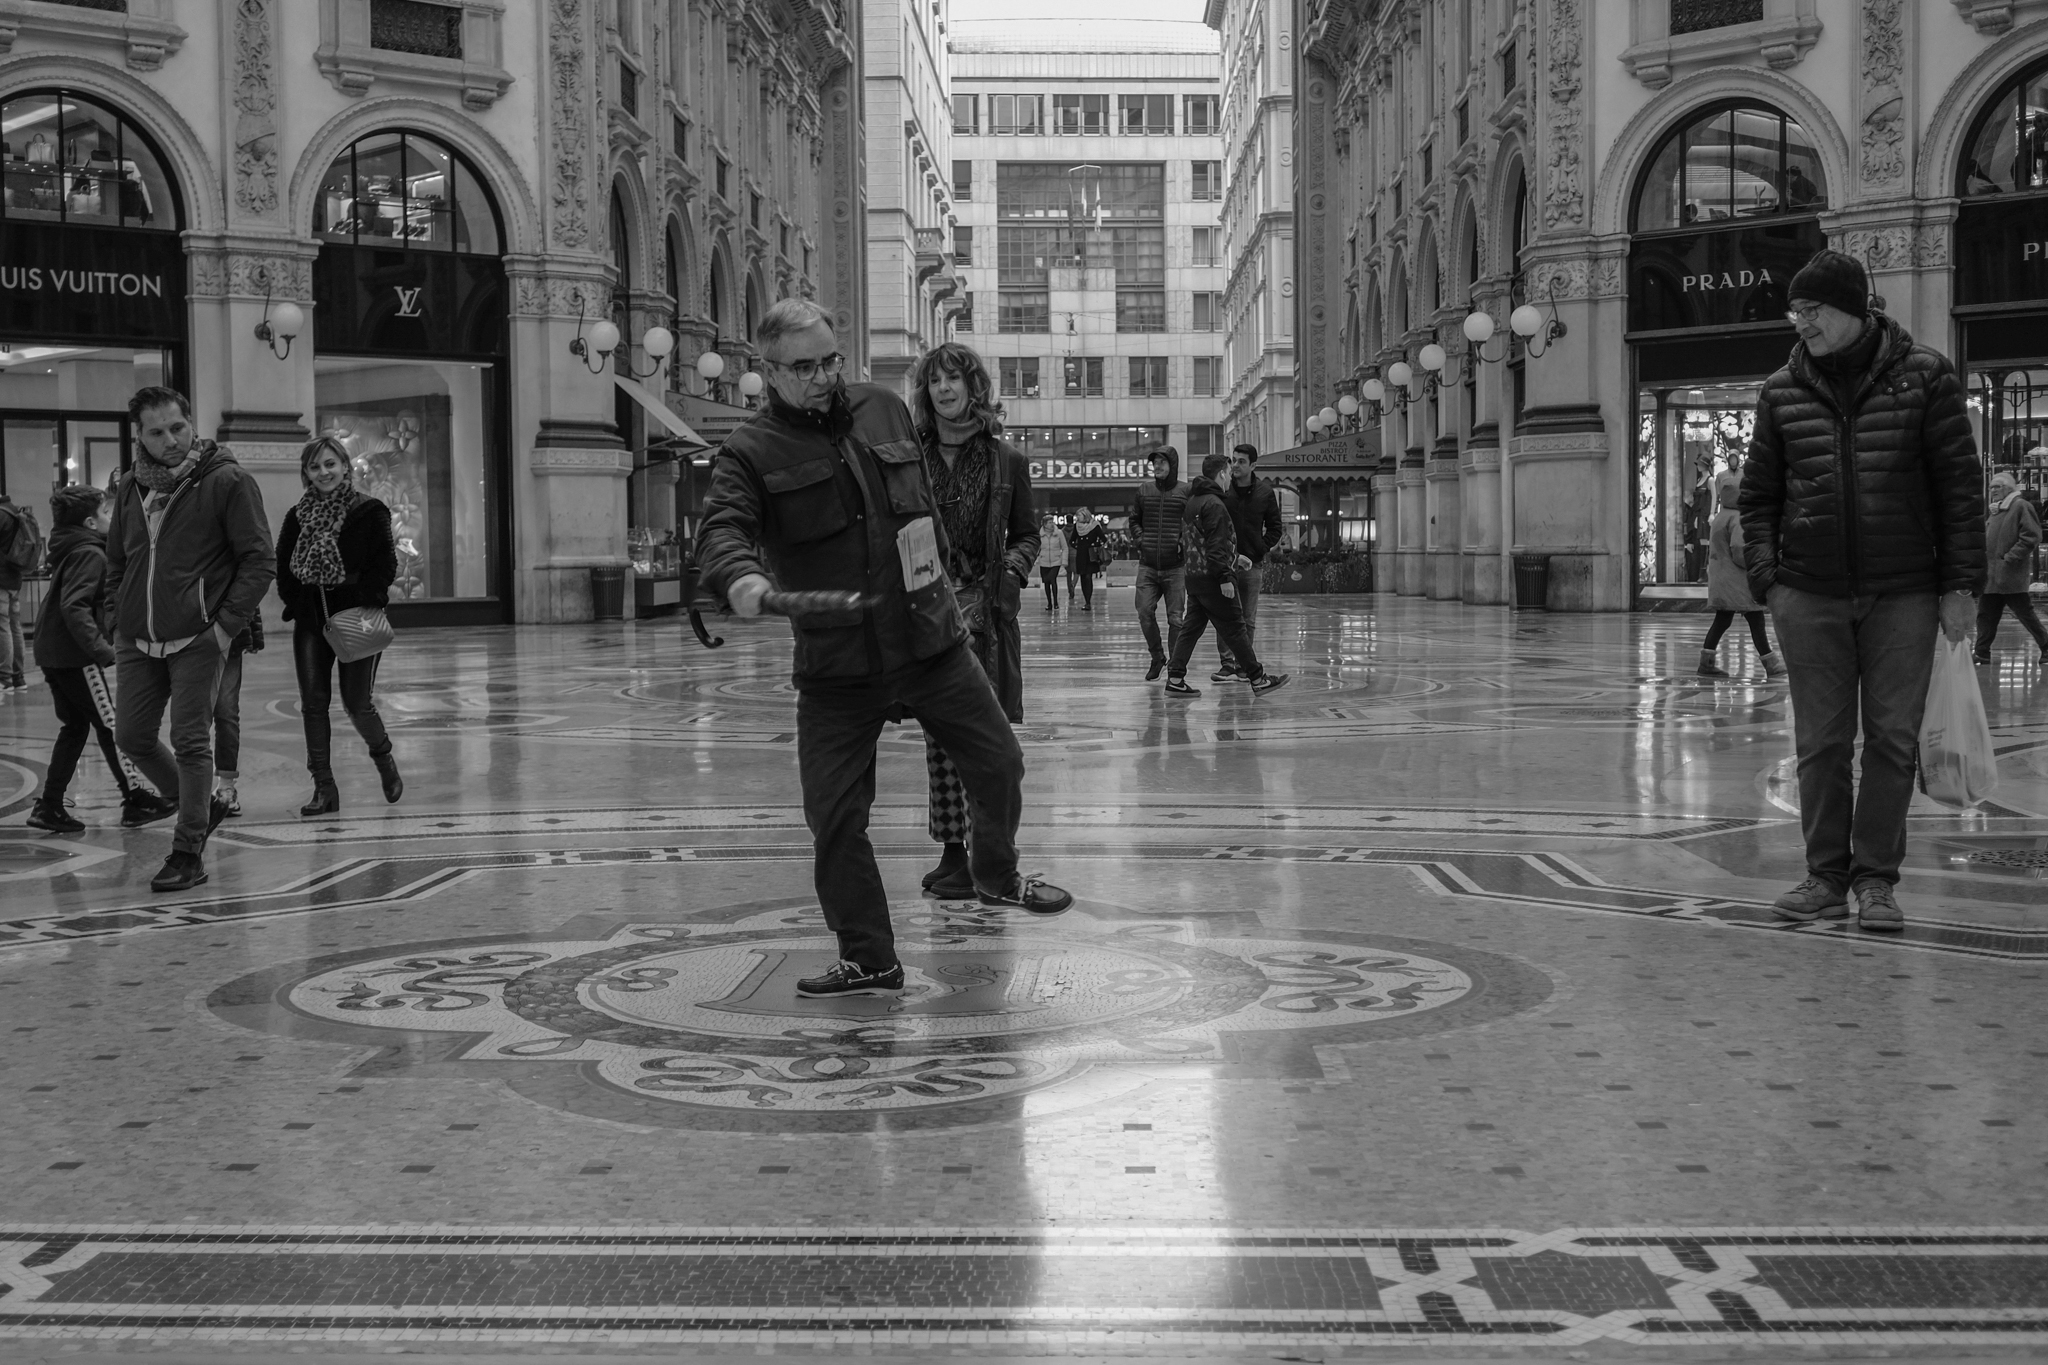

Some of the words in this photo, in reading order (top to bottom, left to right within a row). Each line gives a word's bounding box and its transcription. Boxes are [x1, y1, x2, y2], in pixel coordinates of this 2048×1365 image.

[2022, 242, 2048, 261] P
[1, 266, 43, 291] UIS
[49, 269, 161, 298] VUITTON
[1682, 268, 1774, 293] PRADA
[1285, 454, 1349, 463] RISTORANTE
